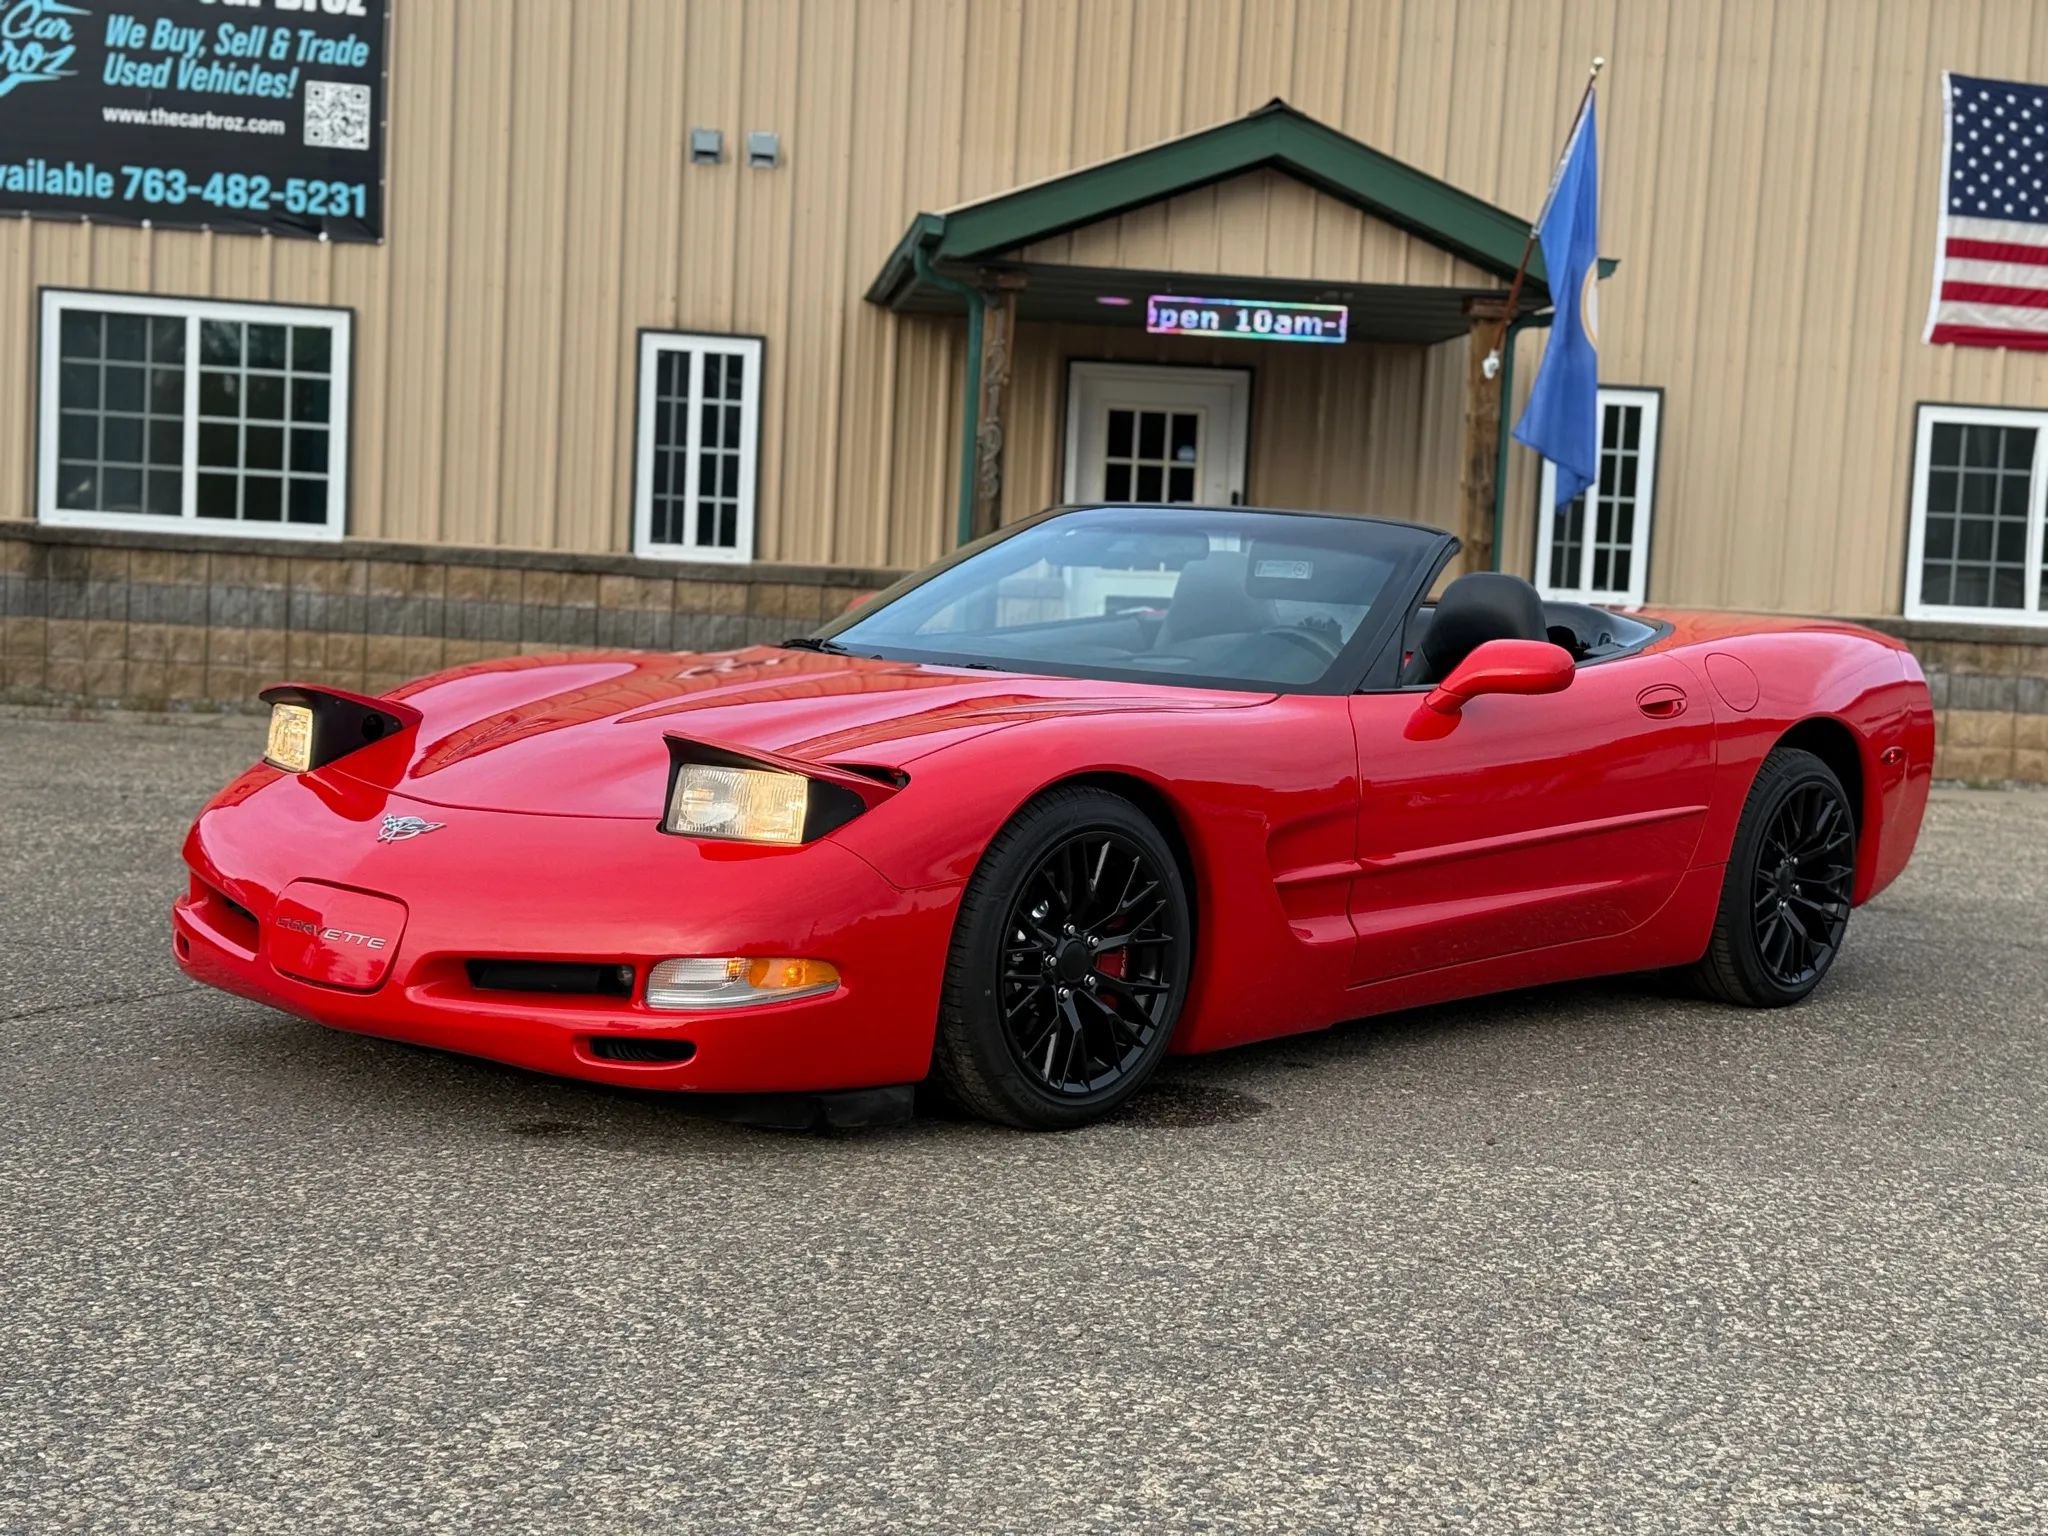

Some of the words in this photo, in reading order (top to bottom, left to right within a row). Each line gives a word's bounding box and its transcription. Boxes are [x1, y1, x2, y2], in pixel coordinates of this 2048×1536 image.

[1, 0, 75, 41] Car
[0, 39, 78, 76] roz
[104, 13, 148, 48] We
[151, 17, 207, 58] Buy,
[213, 22, 267, 58] Sell
[268, 26, 291, 61] &
[297, 30, 370, 68] Trade
[103, 52, 171, 89] Used
[176, 58, 300, 99] Vehicles!
[102, 106, 286, 135] www.thecarbroz.com
[121, 165, 366, 218] 763-482-5231
[1235, 309, 1346, 336] 10am-
[276, 917, 387, 950] CORVETTE
